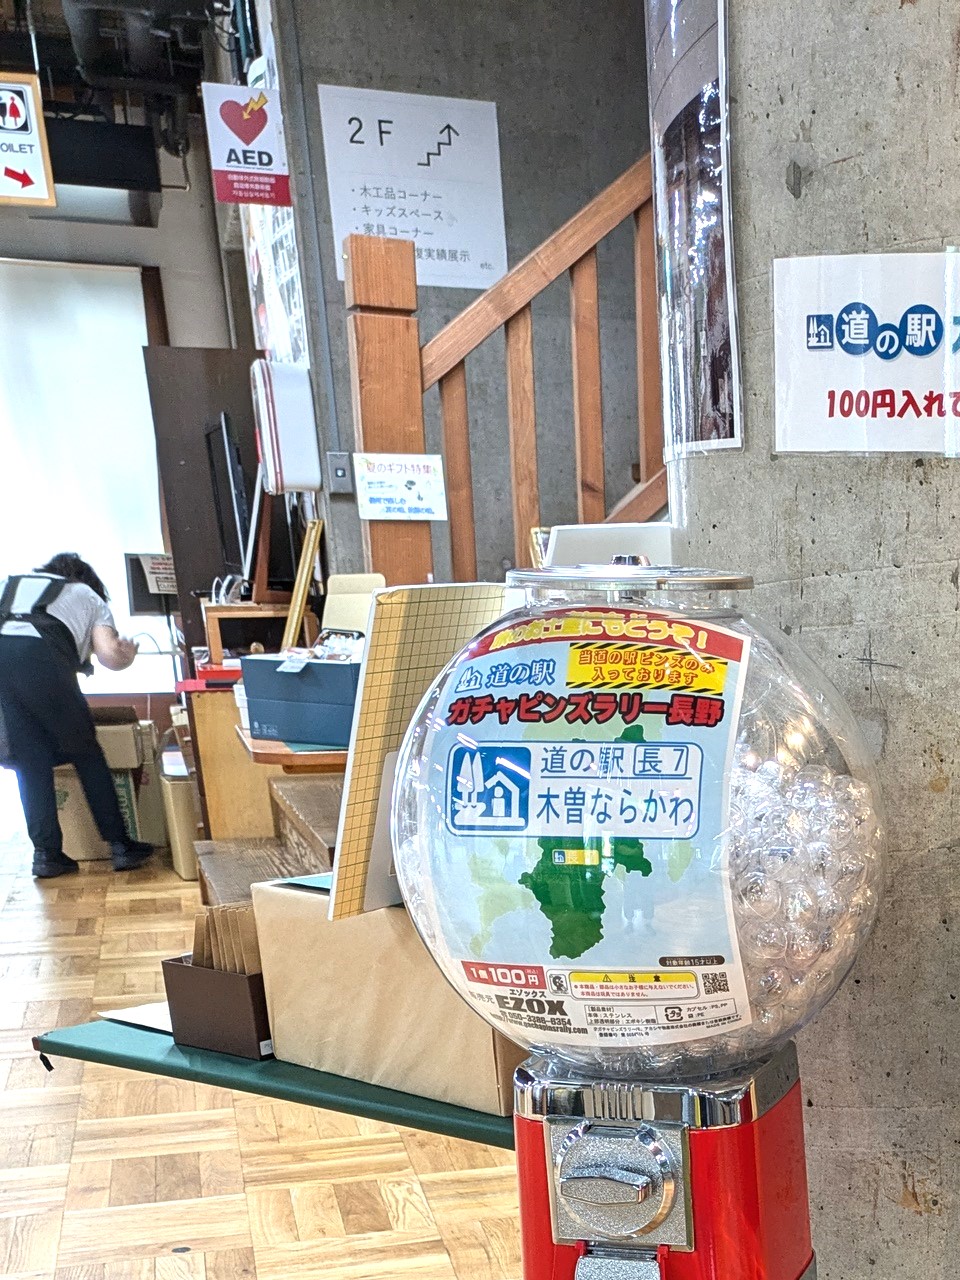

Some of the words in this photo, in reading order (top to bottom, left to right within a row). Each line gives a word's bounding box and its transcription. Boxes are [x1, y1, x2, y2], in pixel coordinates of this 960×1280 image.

[226, 148, 273, 167] AED
[486, 659, 556, 688] 道の駅
[592, 667, 698, 686] 入っております
[446, 690, 725, 727] ガチャピンズラリー長野
[536, 786, 695, 827] 木曽ならかわ
[495, 994, 568, 1016] EZOX
